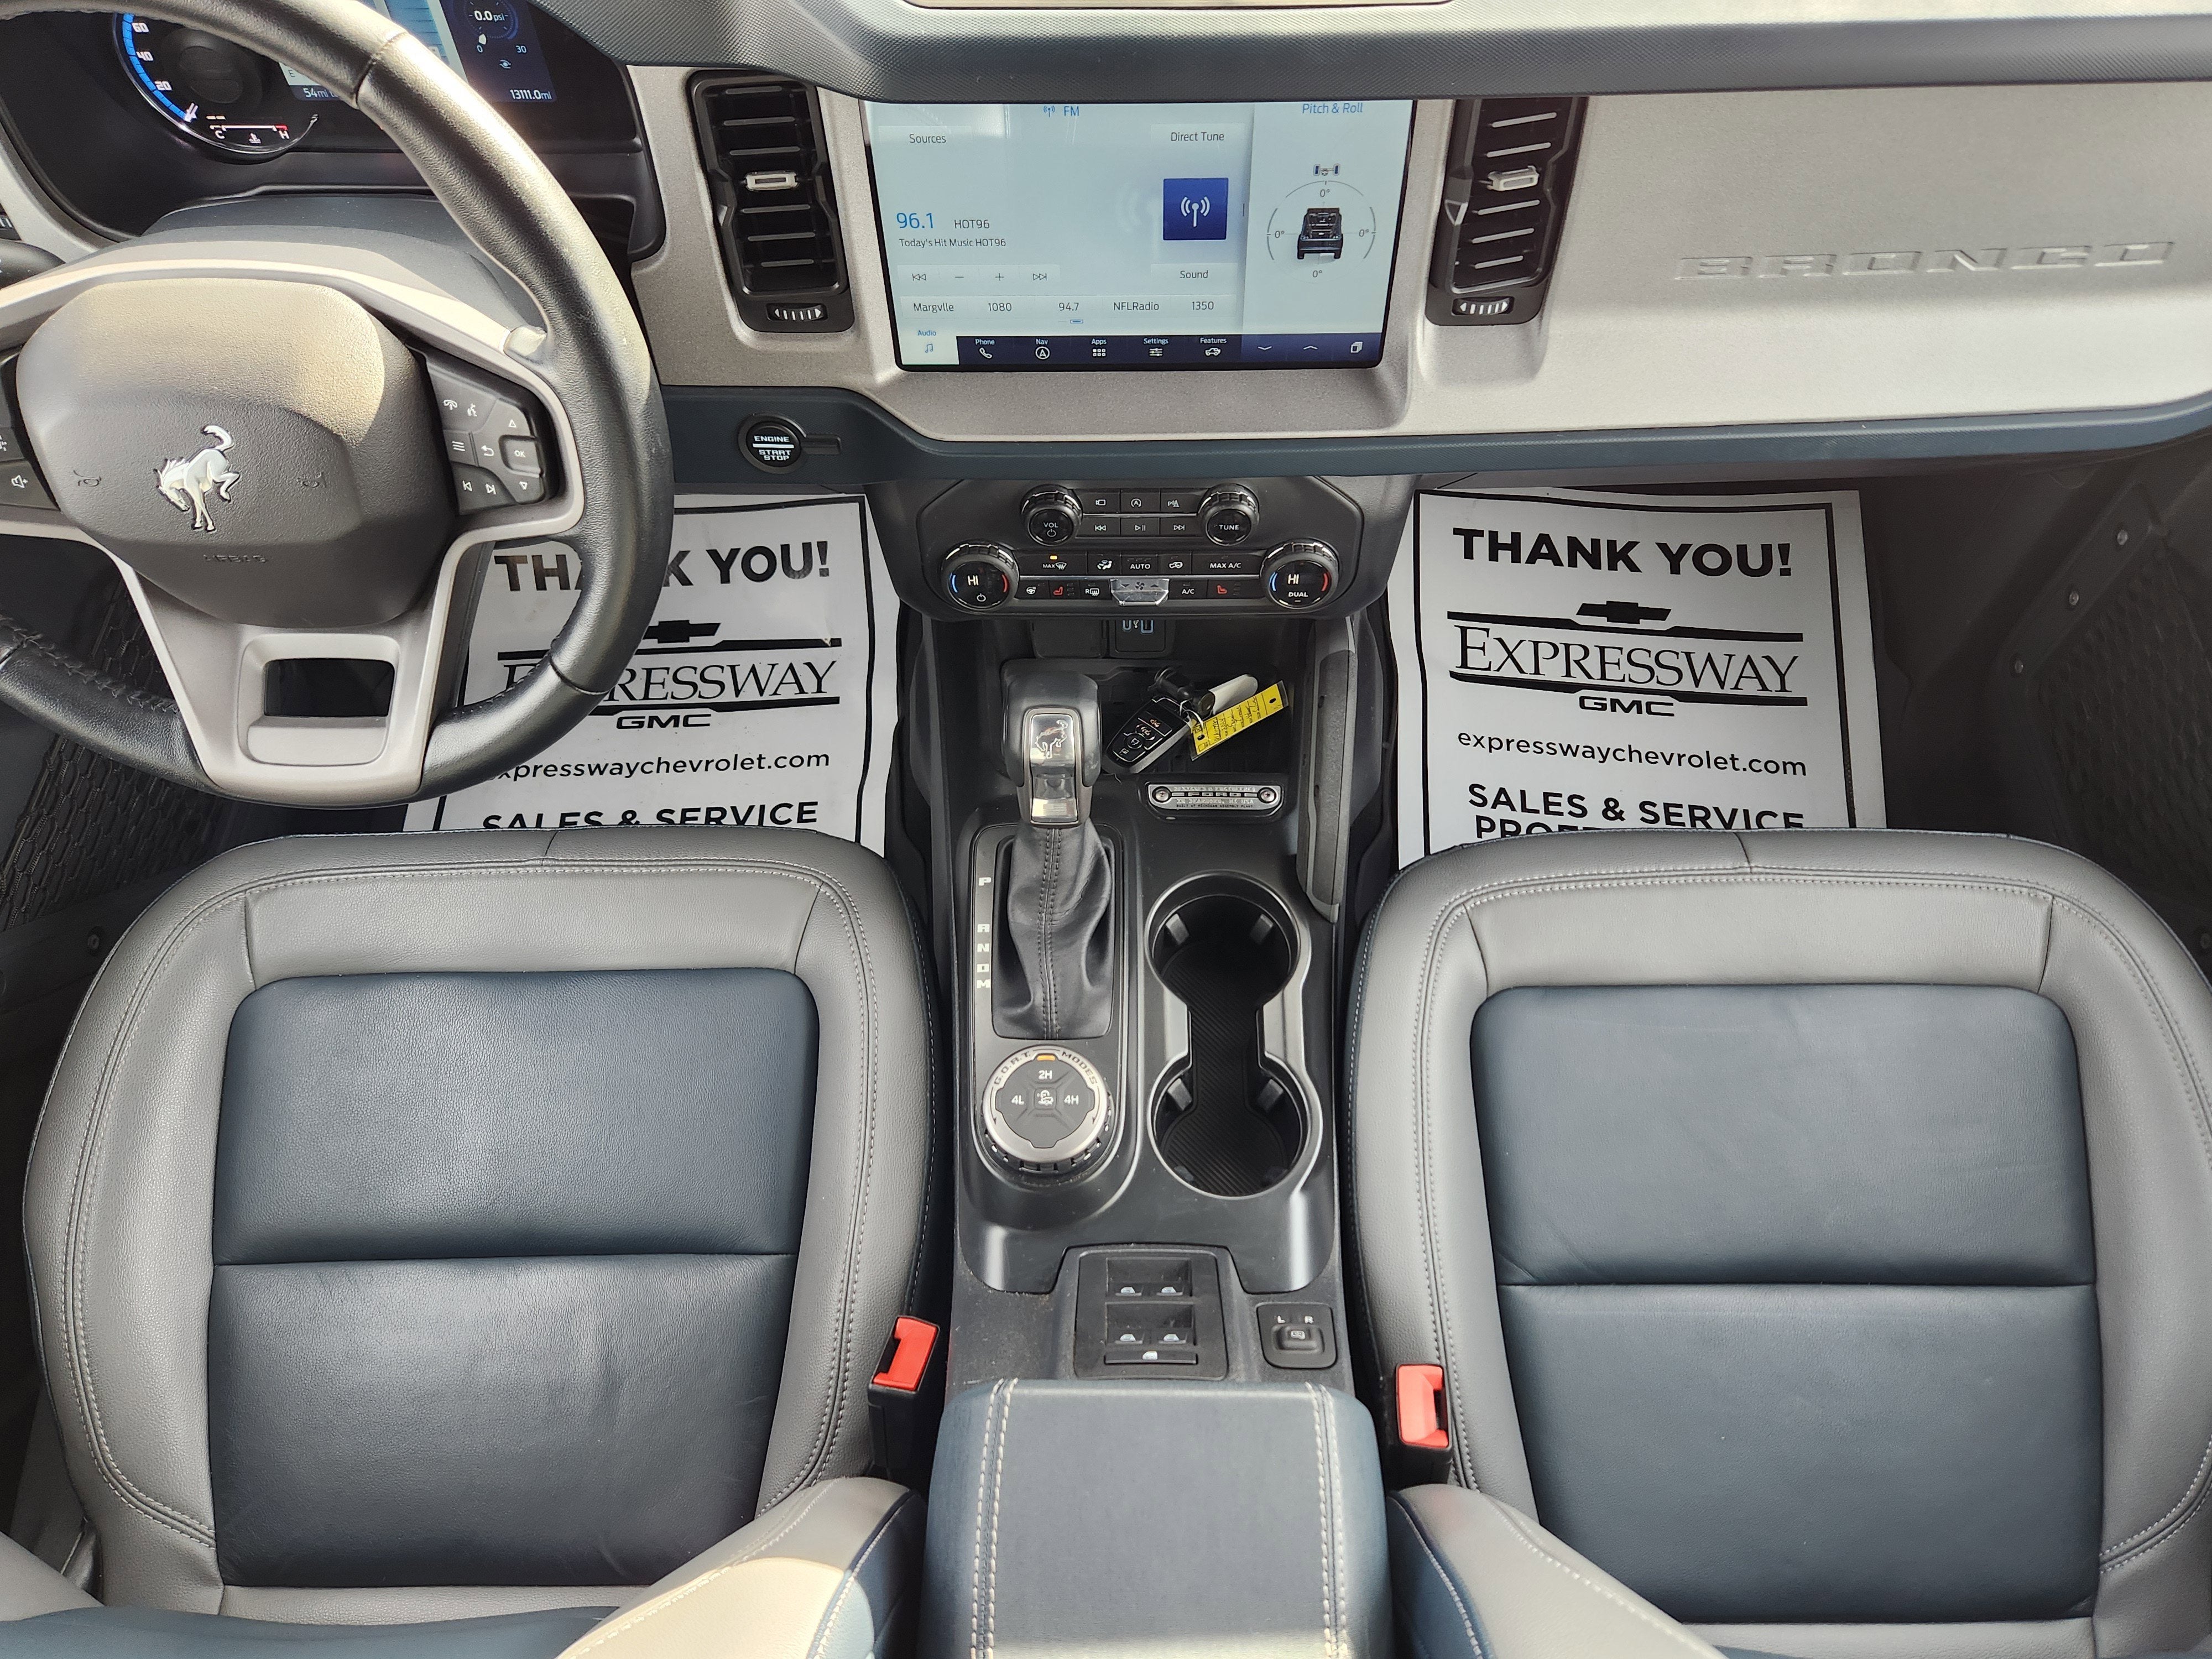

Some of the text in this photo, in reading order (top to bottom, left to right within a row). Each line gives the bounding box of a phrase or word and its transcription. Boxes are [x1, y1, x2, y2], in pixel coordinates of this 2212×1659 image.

[132, 23, 149, 33] 60
[477, 45, 483, 54] 0
[515, 45, 527, 54] 30
[136, 51, 154, 61] 40
[288, 69, 295, 77] E
[154, 81, 173, 91] 20
[1063, 106, 1080, 116] FM
[1302, 102, 1363, 114] Pitch & Roll
[215, 130, 226, 139] C
[279, 131, 290, 140] H
[909, 133, 947, 144] Sources
[1171, 132, 1224, 142] Direct Tune
[896, 212, 935, 229] 96.1
[954, 219, 990, 229] HOT96
[899, 238, 1006, 248] Today's Hit Music HOT96
[1674, 240, 2175, 280] BRONCO
[1180, 270, 1208, 279] Sound
[988, 302, 1012, 312] 1080
[1058, 302, 1079, 312] 94.7
[1113, 301, 1160, 311] NFLRadio
[1192, 301, 1214, 310] 1350
[1143, 337, 1169, 346] Settings
[514, 450, 526, 458] OK
[1453, 527, 1793, 577] THANK YOU!
[494, 540, 831, 592] THK YOU!
[967, 575, 979, 586] HI
[1287, 573, 1300, 585] HI
[1454, 624, 1799, 693] EXPRESSWAY
[1578, 695, 1675, 717] GMC
[615, 713, 712, 730] GMC
[1457, 730, 1807, 776] expresswaychevrolet.com
[1468, 783, 1804, 830] SALES & SERVICE
[656, 801, 818, 827] SERVICE
[978, 877, 992, 886] P
[977, 943, 990, 952] N
[977, 963, 989, 973] D
[976, 979, 990, 989] M
[1061, 1051, 1098, 1086] MODES
[1038, 1070, 1052, 1080] 2H
[1011, 1095, 1025, 1105] 4L
[1063, 1095, 1079, 1105] 4H
[1277, 1314, 1286, 1323] L
[1304, 1315, 1314, 1324] R
